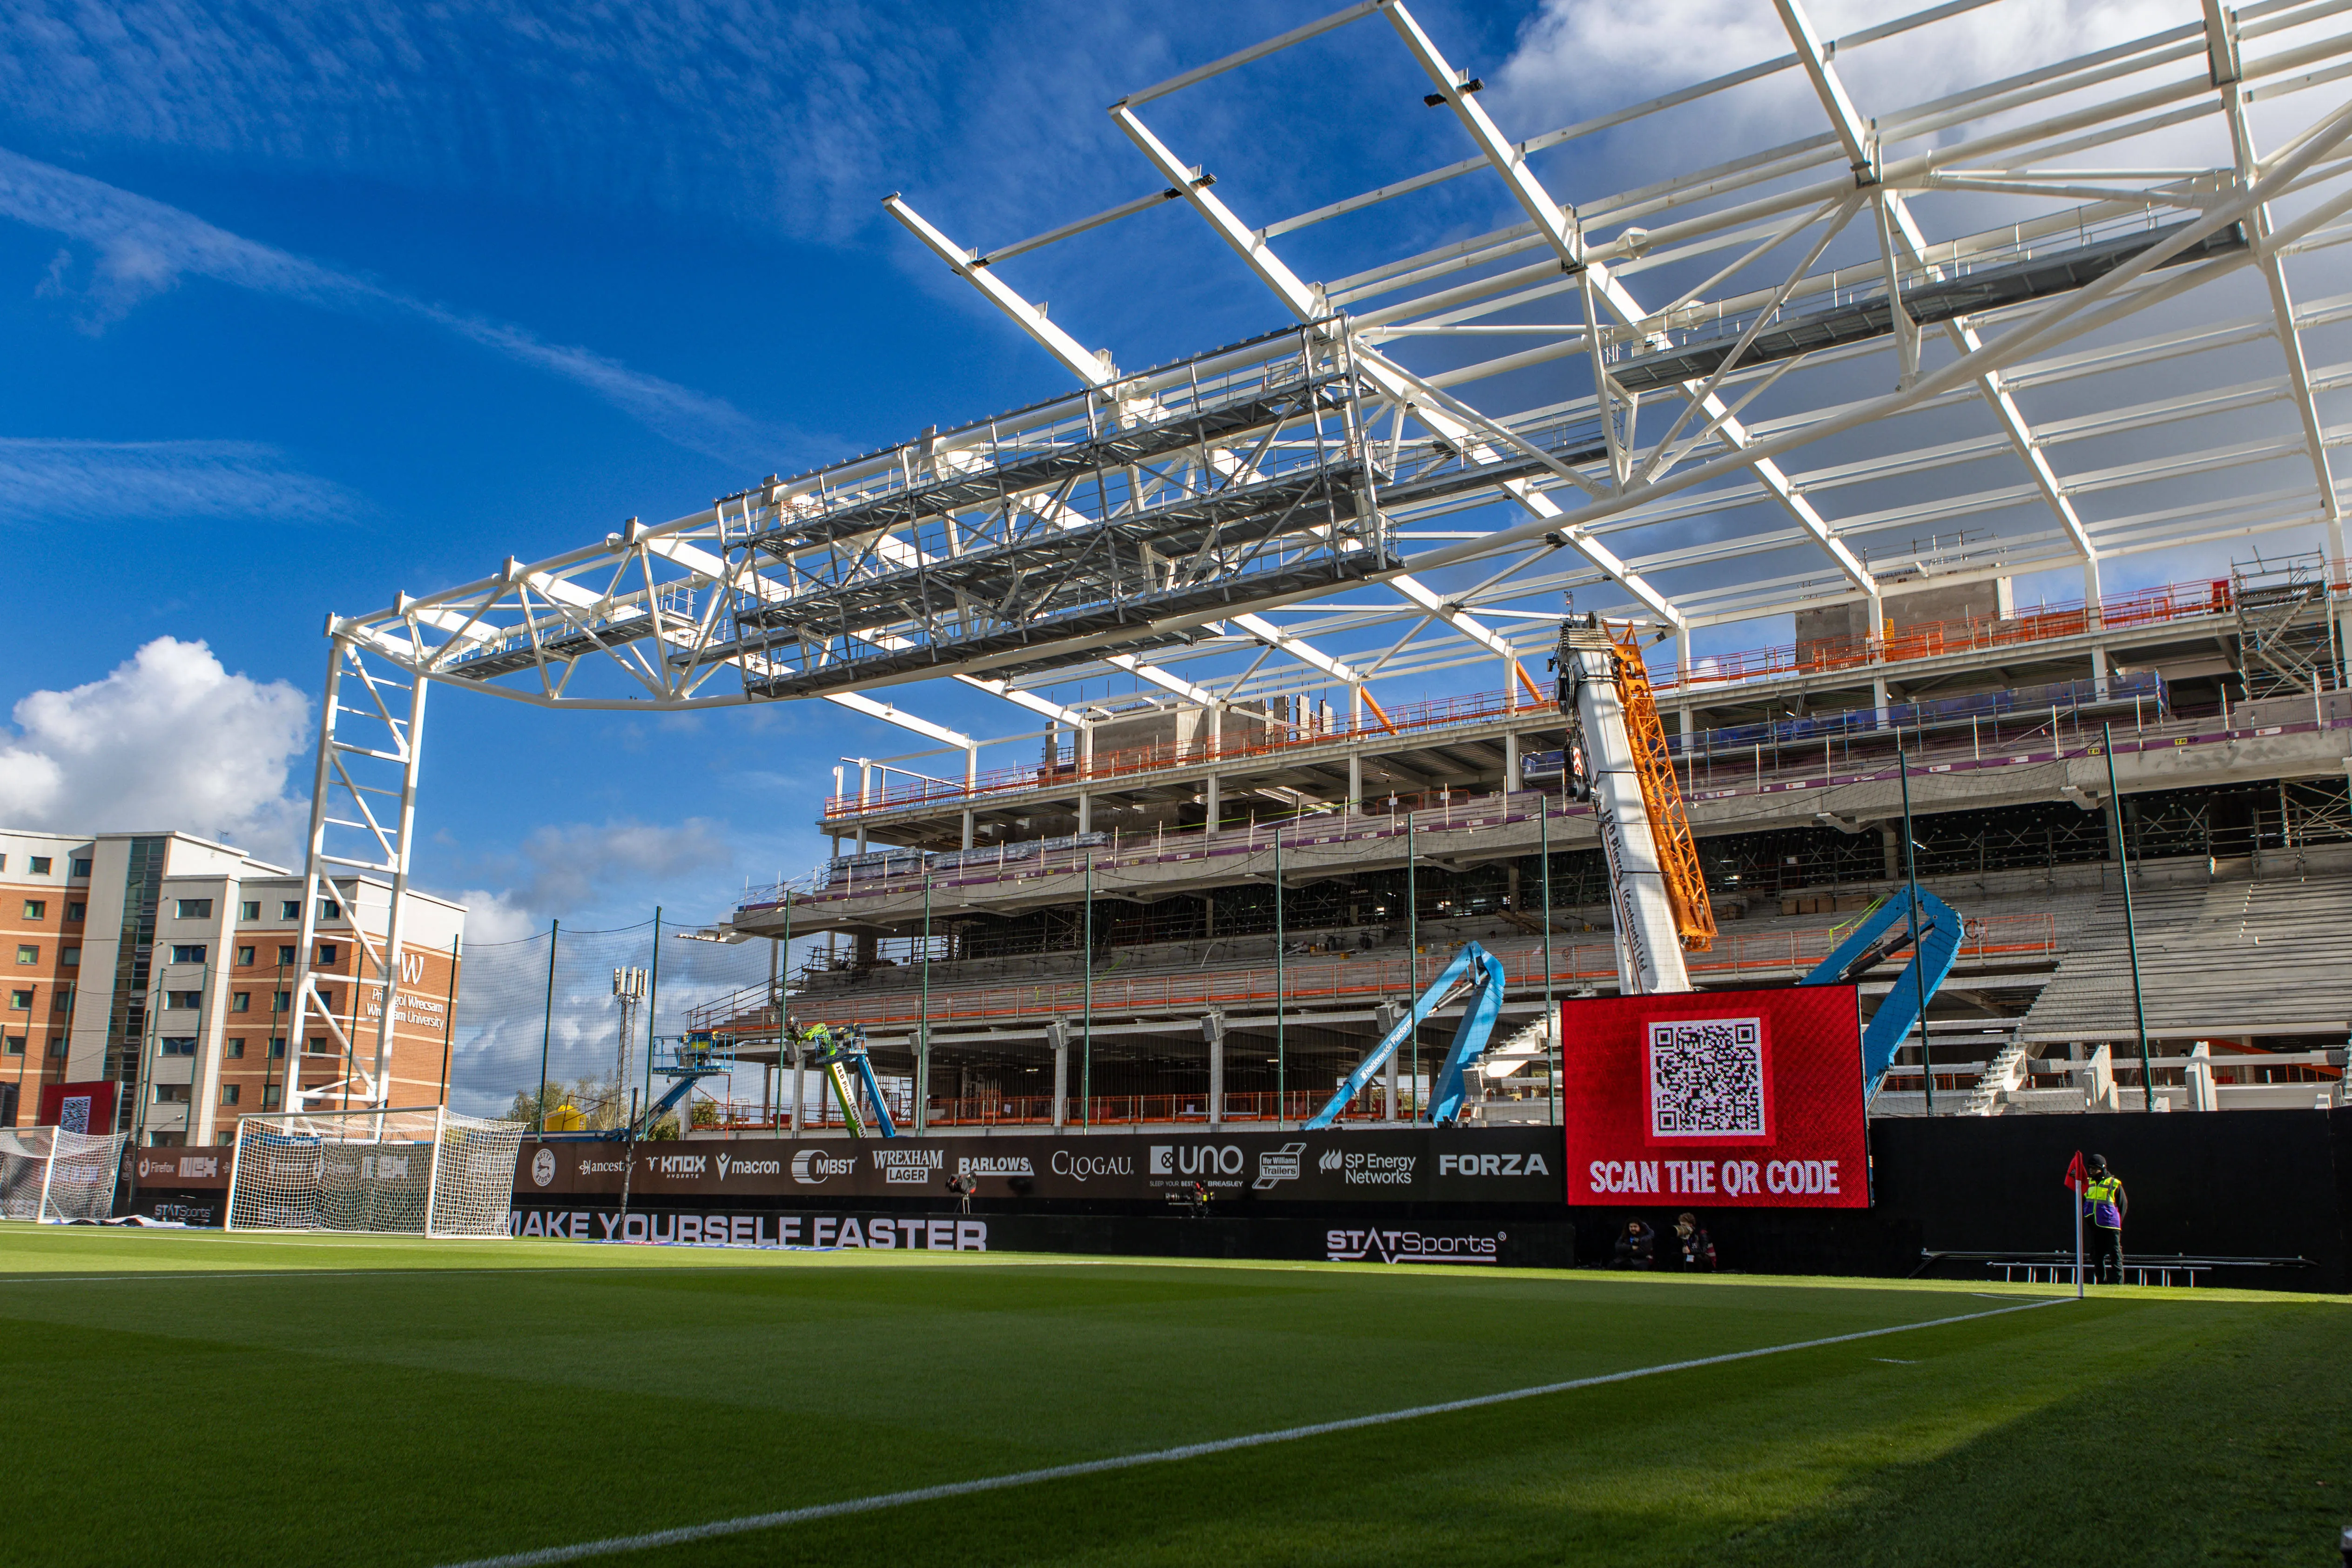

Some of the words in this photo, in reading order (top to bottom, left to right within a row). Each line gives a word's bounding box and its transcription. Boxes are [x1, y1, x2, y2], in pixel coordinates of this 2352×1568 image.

[1603, 808, 1616, 836] J&D
[1611, 836, 1623, 877] Pierce
[1622, 889, 1643, 952] (Contracts)
[1636, 951, 1648, 973] Ltd
[401, 952, 424, 985] W
[372, 988, 407, 1008] Prigol
[407, 995, 444, 1013] Wrecsam
[366, 1003, 406, 1022] Wram
[407, 1010, 444, 1031] University
[1364, 1043, 1393, 1076] Nationwide
[836, 1065, 845, 1079] J&D
[842, 1081, 852, 1102] Pierce
[151, 1162, 175, 1173] Firefox
[660, 1155, 707, 1172] KNOX
[732, 1160, 780, 1174] macron
[815, 1158, 856, 1174] MBST
[872, 1150, 943, 1169] WREXHAM
[958, 1157, 1030, 1174] BARLOWS
[1051, 1151, 1131, 1181] CLOGAU
[1345, 1154, 1364, 1169] SP
[1368, 1154, 1416, 1171] Energy
[1439, 1154, 1550, 1176] FORZA
[889, 1169, 926, 1181] LAGER
[1346, 1169, 1412, 1184] Networks
[1590, 1160, 1660, 1193] SCAN
[1665, 1160, 1716, 1193] THE
[1722, 1160, 1761, 1197] QR
[1766, 1159, 1840, 1194] CODE
[598, 1213, 802, 1245] YOURSELF
[813, 1218, 987, 1251] FASTER
